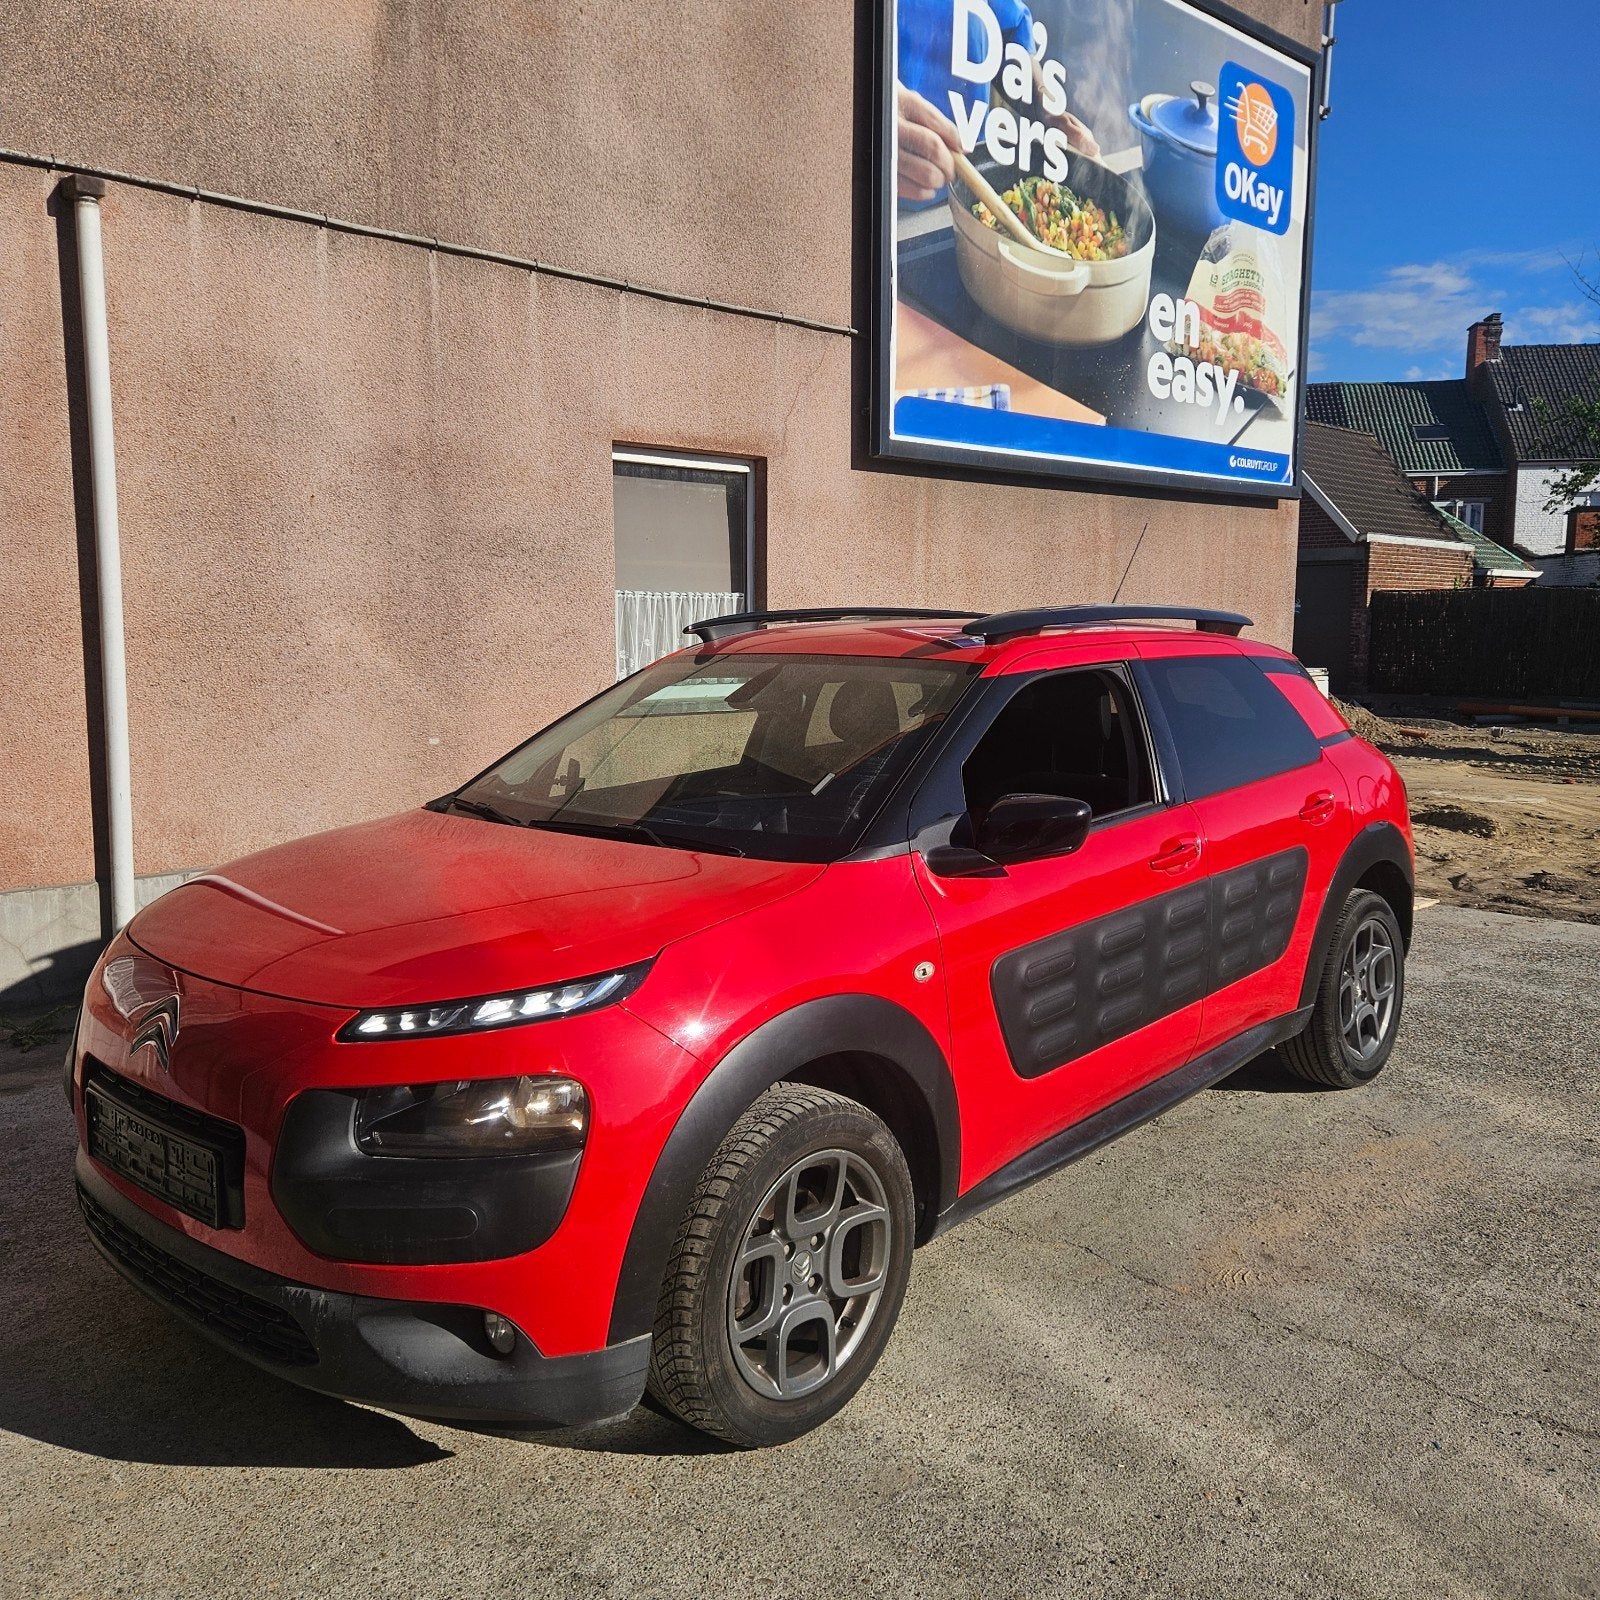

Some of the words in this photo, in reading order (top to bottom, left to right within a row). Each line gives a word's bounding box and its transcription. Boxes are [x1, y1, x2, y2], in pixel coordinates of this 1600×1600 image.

[951, 0, 1067, 116] Da's
[947, 90, 1069, 183] vers
[1224, 162, 1283, 225] OKay
[1149, 293, 1201, 348] en
[1147, 352, 1245, 426] easy.
